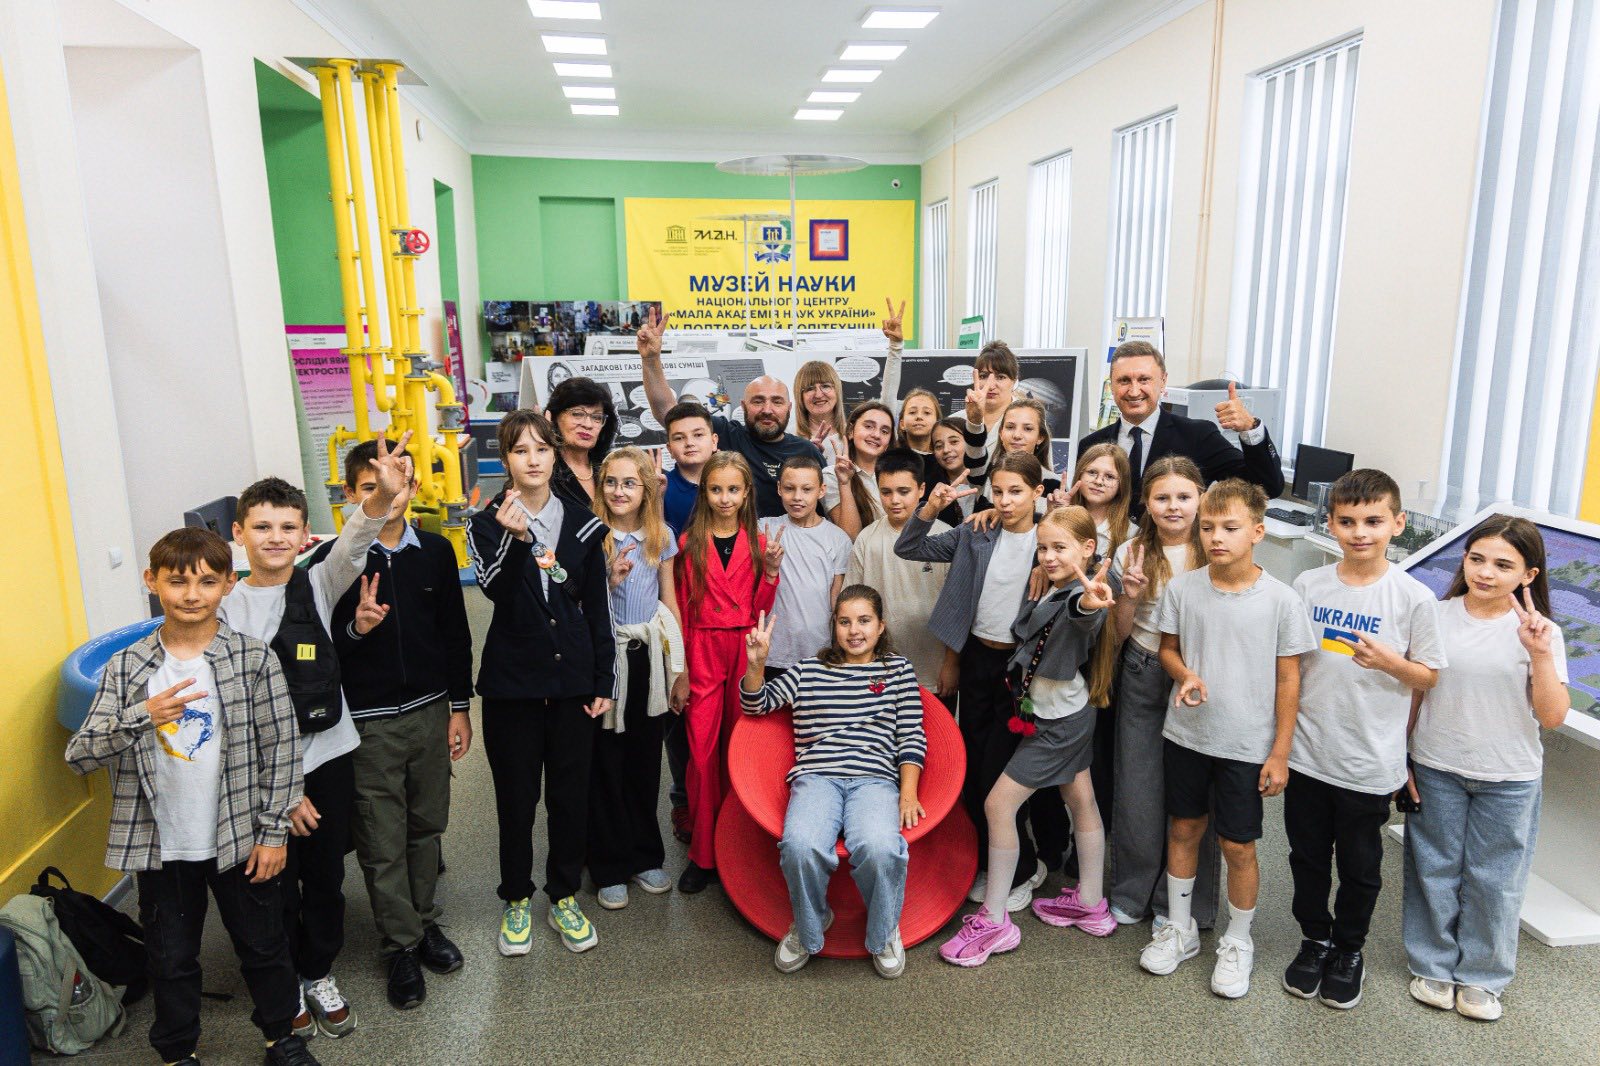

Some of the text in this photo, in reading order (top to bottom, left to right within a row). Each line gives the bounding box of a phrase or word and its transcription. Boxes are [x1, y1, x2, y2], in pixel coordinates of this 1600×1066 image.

[690, 271, 856, 292] МУЗЕЙ НАУКИ
[803, 297, 849, 308] ЦЕНТРУ
[669, 309, 713, 319] «МАЛА
[716, 309, 780, 320] АКАДЕМІЯ
[818, 307, 876, 318] УКРАЇНИ»
[329, 356, 349, 365] ЯВИ
[580, 363, 623, 372] ЗАГАДКОВІ
[678, 361, 704, 369] СУМІШІ
[1313, 606, 1381, 634] UKRAINE
